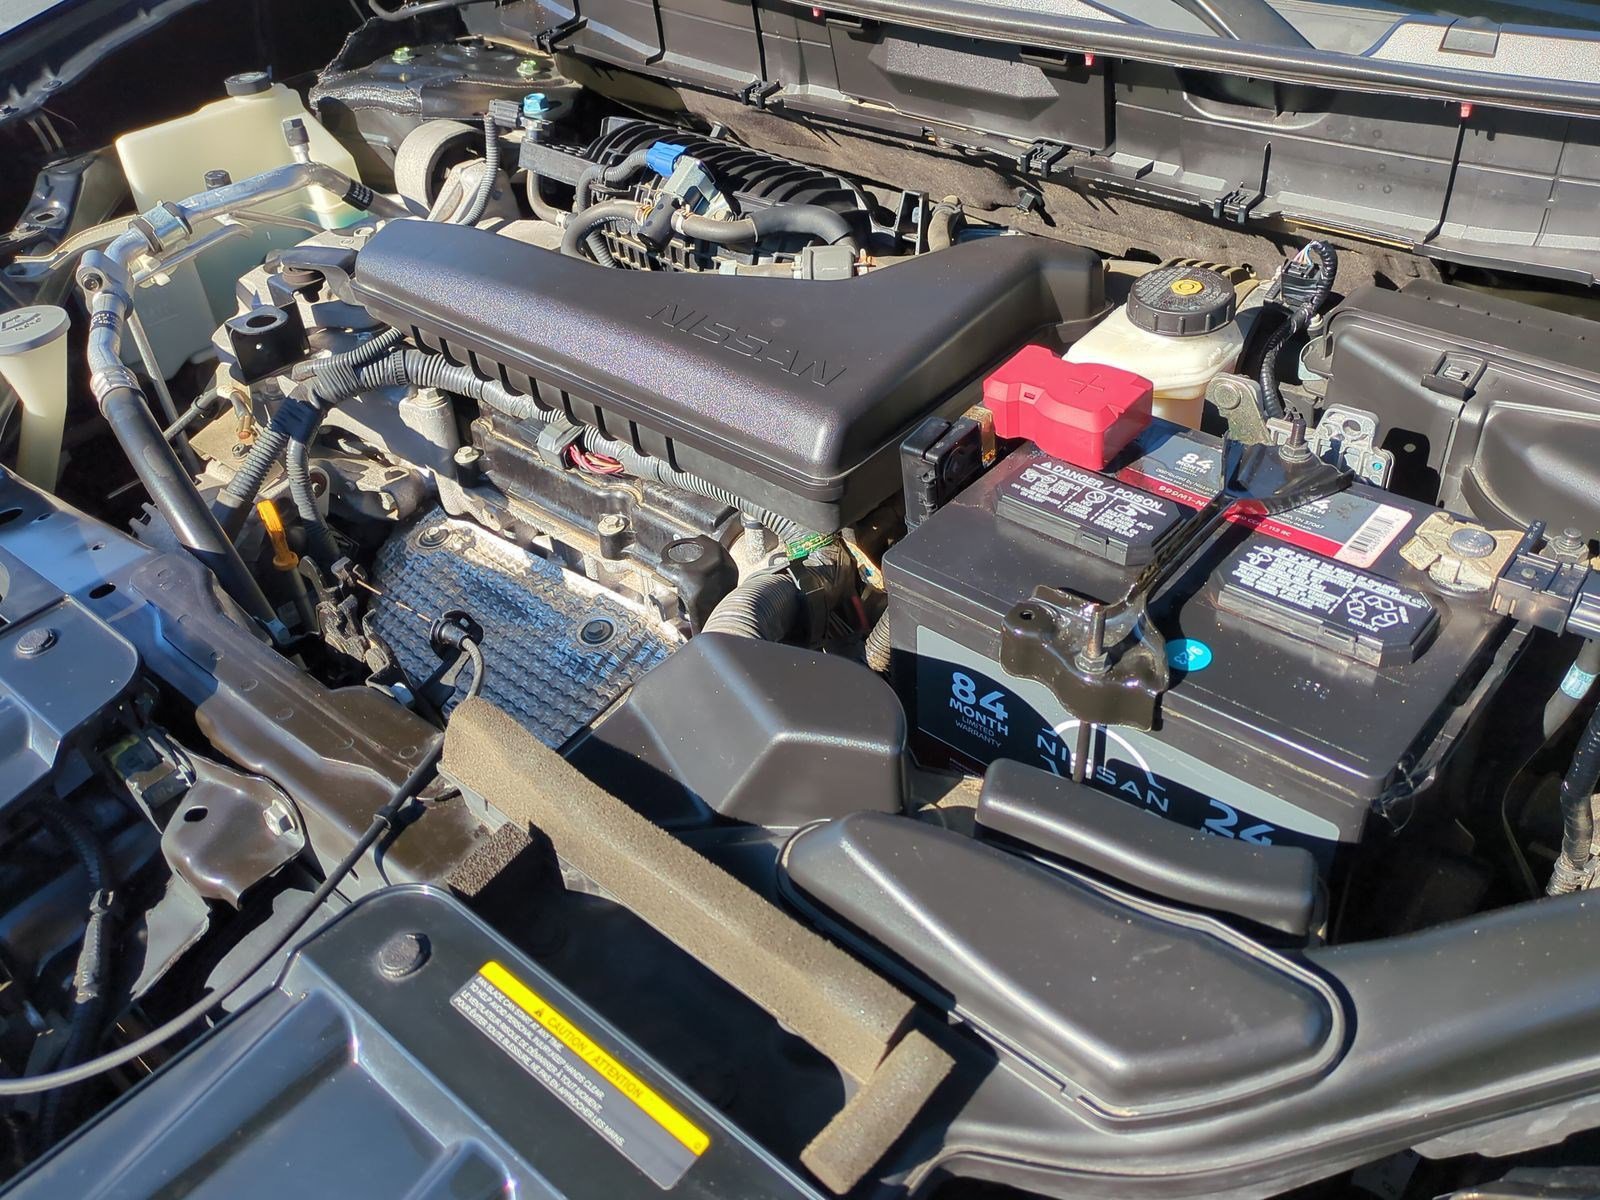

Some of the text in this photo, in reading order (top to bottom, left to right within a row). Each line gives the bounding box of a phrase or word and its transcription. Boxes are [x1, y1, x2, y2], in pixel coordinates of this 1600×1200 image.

[645, 304, 847, 387] NISSAN
[1176, 460, 1207, 474] MONTH
[1181, 452, 1214, 470] 84
[1052, 464, 1102, 487] DANGER
[1113, 487, 1163, 509] POISON
[1311, 498, 1332, 510] 4
[952, 672, 1008, 720] 84
[949, 697, 1008, 736] MONTH
[955, 719, 1001, 748] WARRANTY
[962, 716, 995, 738] LIMITED
[545, 1015, 588, 1053] CAUTION
[590, 1052, 645, 1099] ATTENTION
